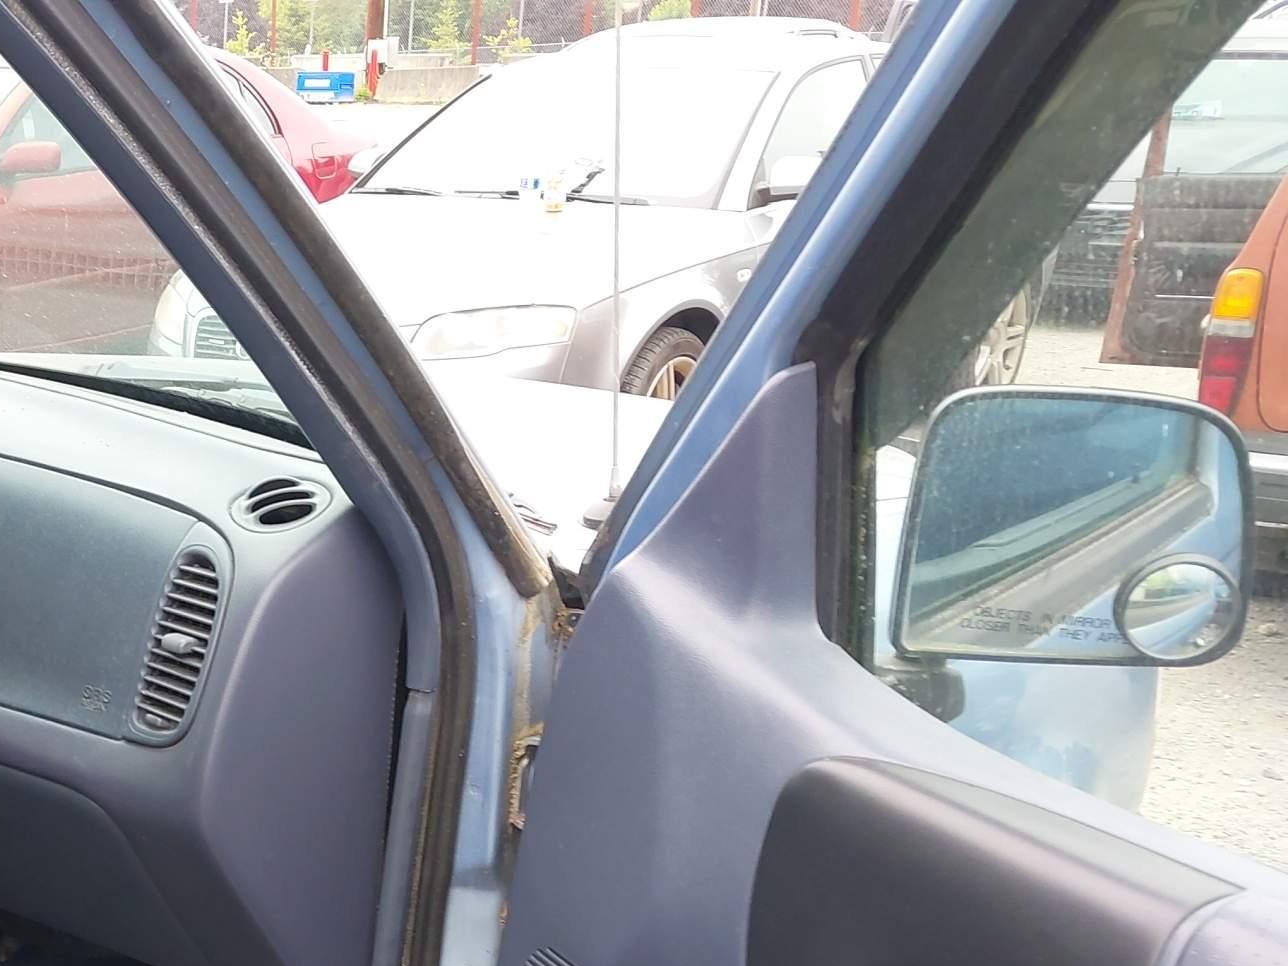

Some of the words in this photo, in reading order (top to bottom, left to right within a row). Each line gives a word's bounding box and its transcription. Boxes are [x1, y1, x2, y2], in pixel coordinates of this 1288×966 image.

[975, 605, 1032, 622] OBJECTS
[960, 617, 1011, 633] CLOSER
[1058, 627, 1089, 641] THEY
